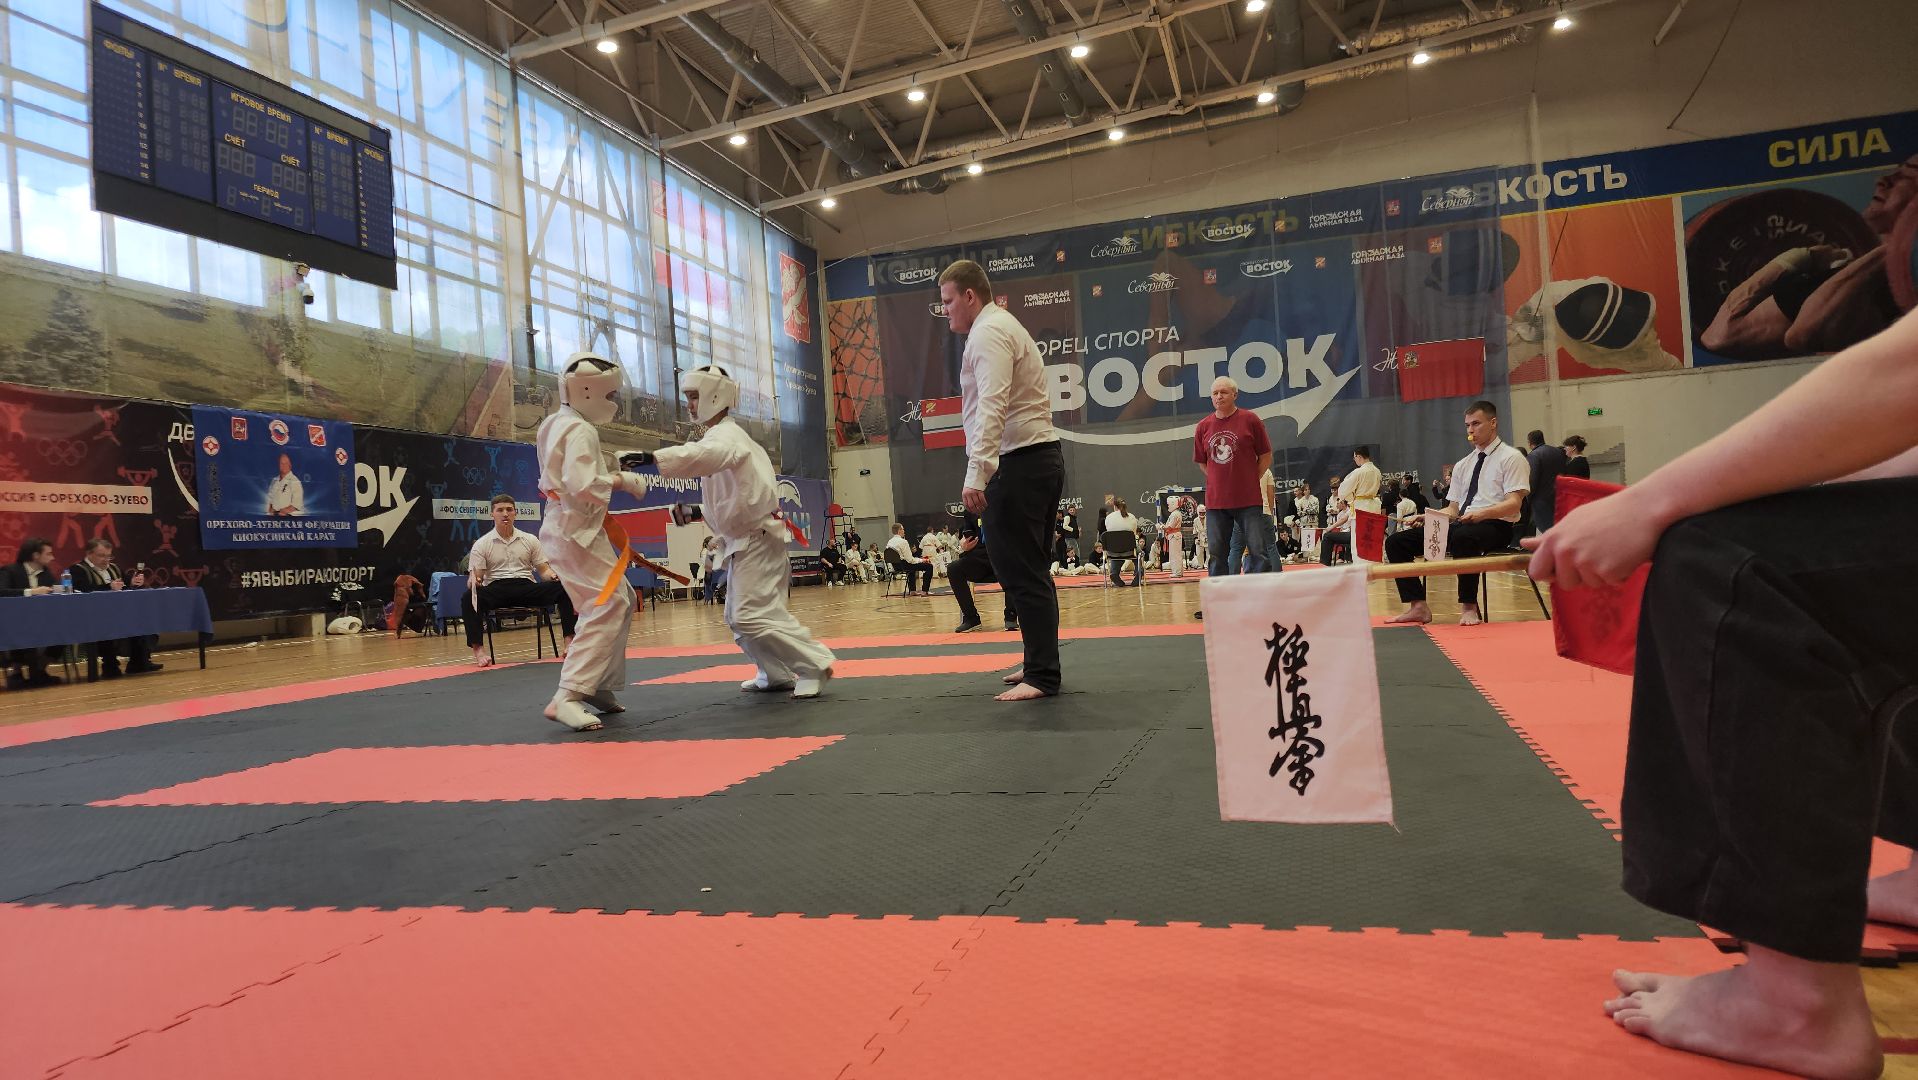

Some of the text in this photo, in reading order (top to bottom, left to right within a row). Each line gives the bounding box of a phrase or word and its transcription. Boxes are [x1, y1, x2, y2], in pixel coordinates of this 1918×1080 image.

[230, 91, 292, 124] ИГРОВОЕ ВРЕМЯ
[1767, 127, 1891, 168] СИЛА
[1344, 215, 1363, 224] БАЗА
[1207, 223, 1252, 238] ВОСТОК
[1091, 244, 1137, 259] Северный
[1386, 252, 1405, 261] БАЗА
[1018, 261, 1035, 270] БАЗА
[1246, 258, 1291, 274] ВОСТОК
[899, 267, 938, 281] ВОСТОК
[1127, 278, 1175, 294] Северный
[1054, 296, 1071, 305] БАЗА
[1036, 325, 1180, 358] ОРЕЦ СПОРТА
[1044, 332, 1338, 413] ВОСТОК
[206, 520, 303, 529] ОРЕХОВО-ЗУЕВСКАЯ
[241, 566, 376, 589] #ЯВЫБИРАЮСПОРТ
